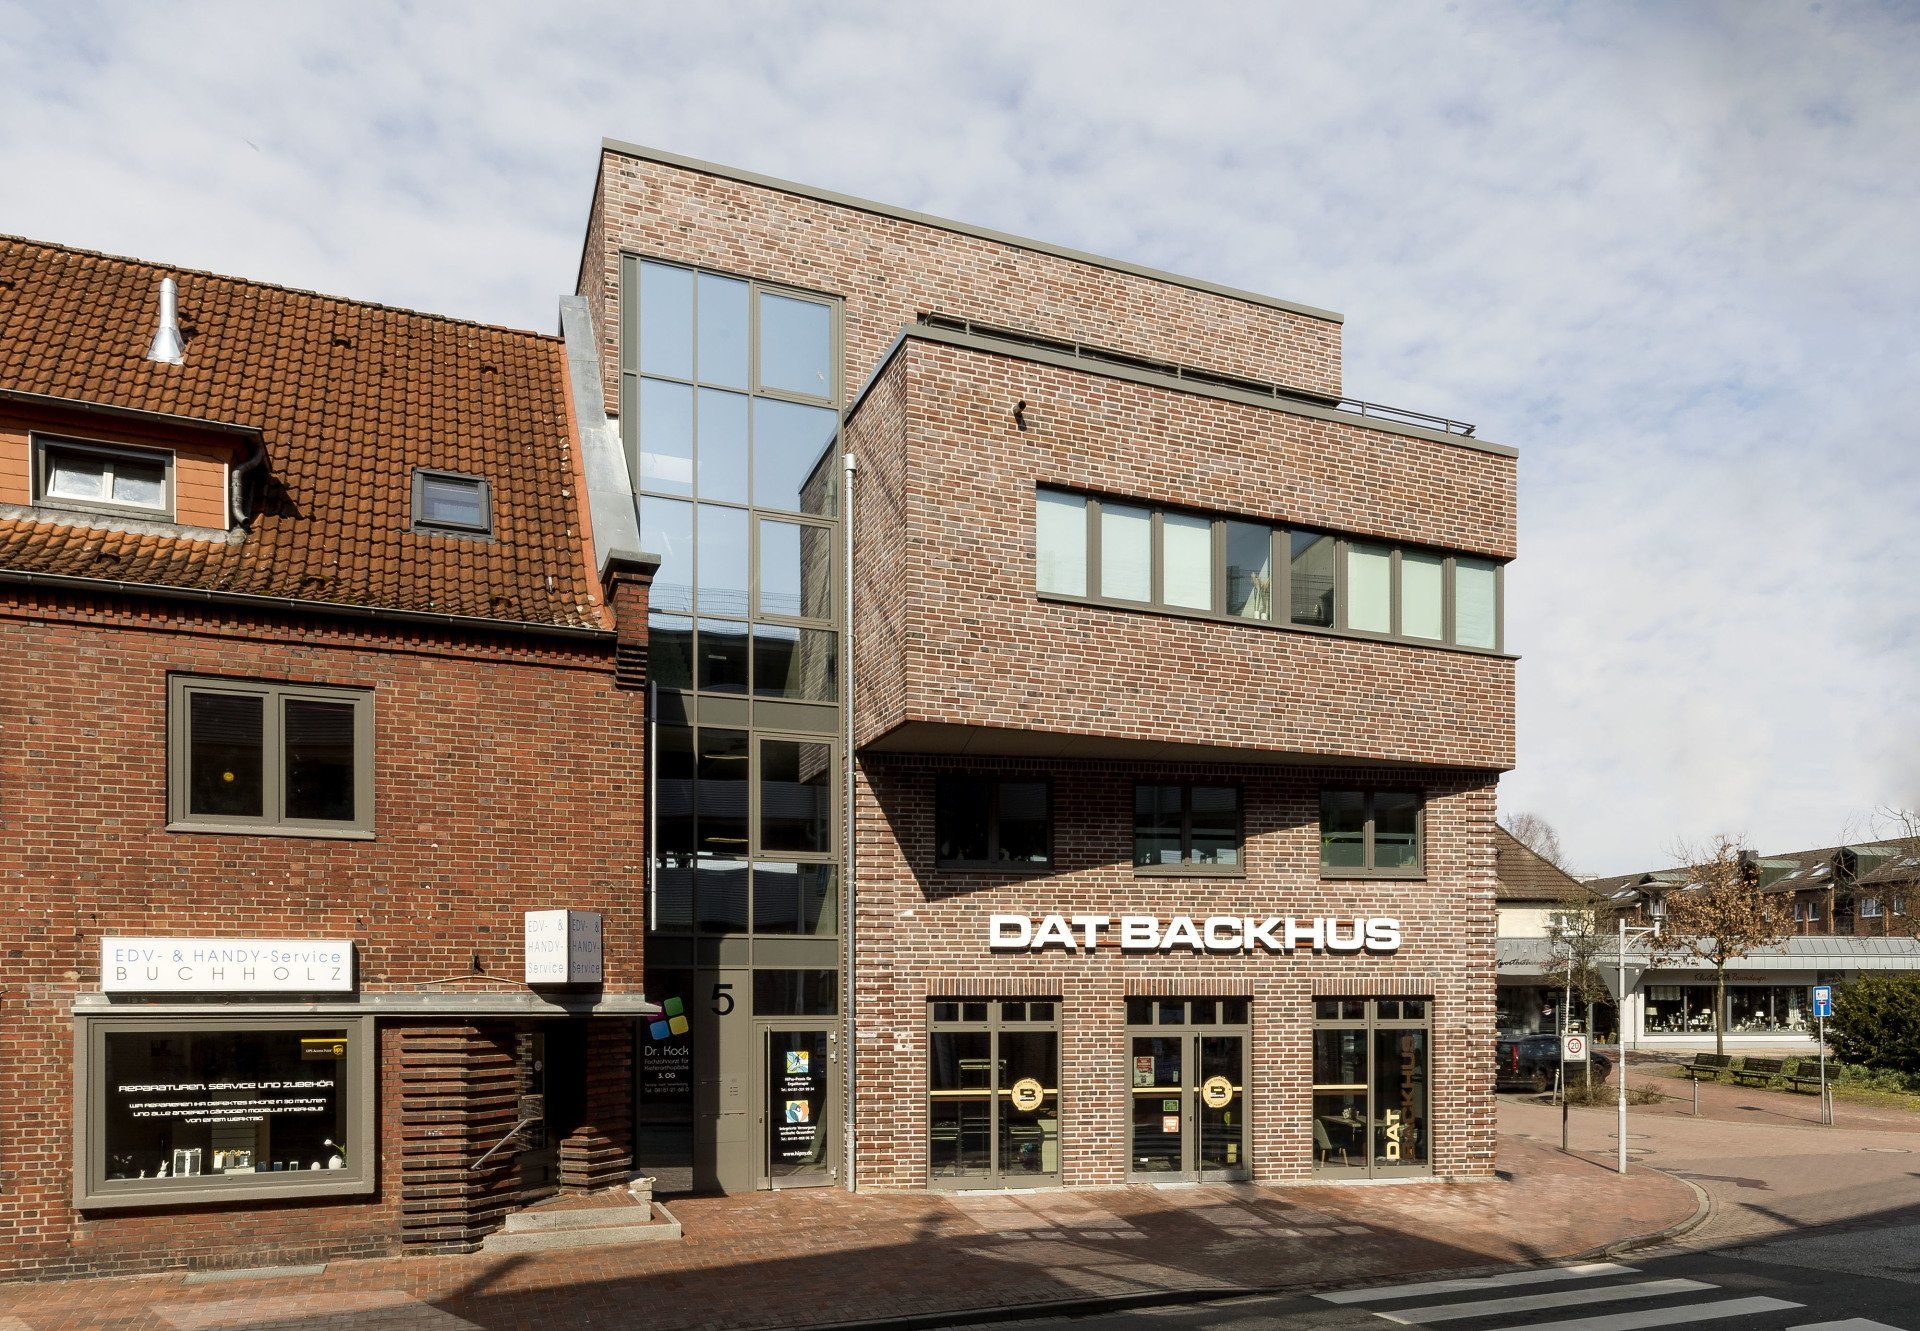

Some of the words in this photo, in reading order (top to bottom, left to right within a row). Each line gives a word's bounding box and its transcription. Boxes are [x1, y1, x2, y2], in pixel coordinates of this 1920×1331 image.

[528, 919, 549, 932] EDV-
[557, 918, 564, 931] &
[572, 918, 588, 931] EDV-
[595, 921, 600, 933] &
[989, 914, 1110, 950] DAT
[1120, 915, 1401, 951] BACKHUS
[528, 940, 563, 953] HANDY-
[572, 940, 600, 953] HANDY-
[115, 949, 162, 962] EDV-
[173, 949, 184, 962] &
[194, 949, 341, 963] HANDY-Service
[116, 966, 341, 981] BUCHHOLZ
[528, 961, 564, 974] Service
[572, 961, 600, 974] Service
[711, 983, 735, 1016] 5
[644, 1045, 660, 1056] Dr.
[663, 1045, 689, 1056] Kock
[1571, 1042, 1578, 1050] 20
[1401, 1034, 1415, 1160] BACKHUS
[1386, 1108, 1400, 1161] DAT
